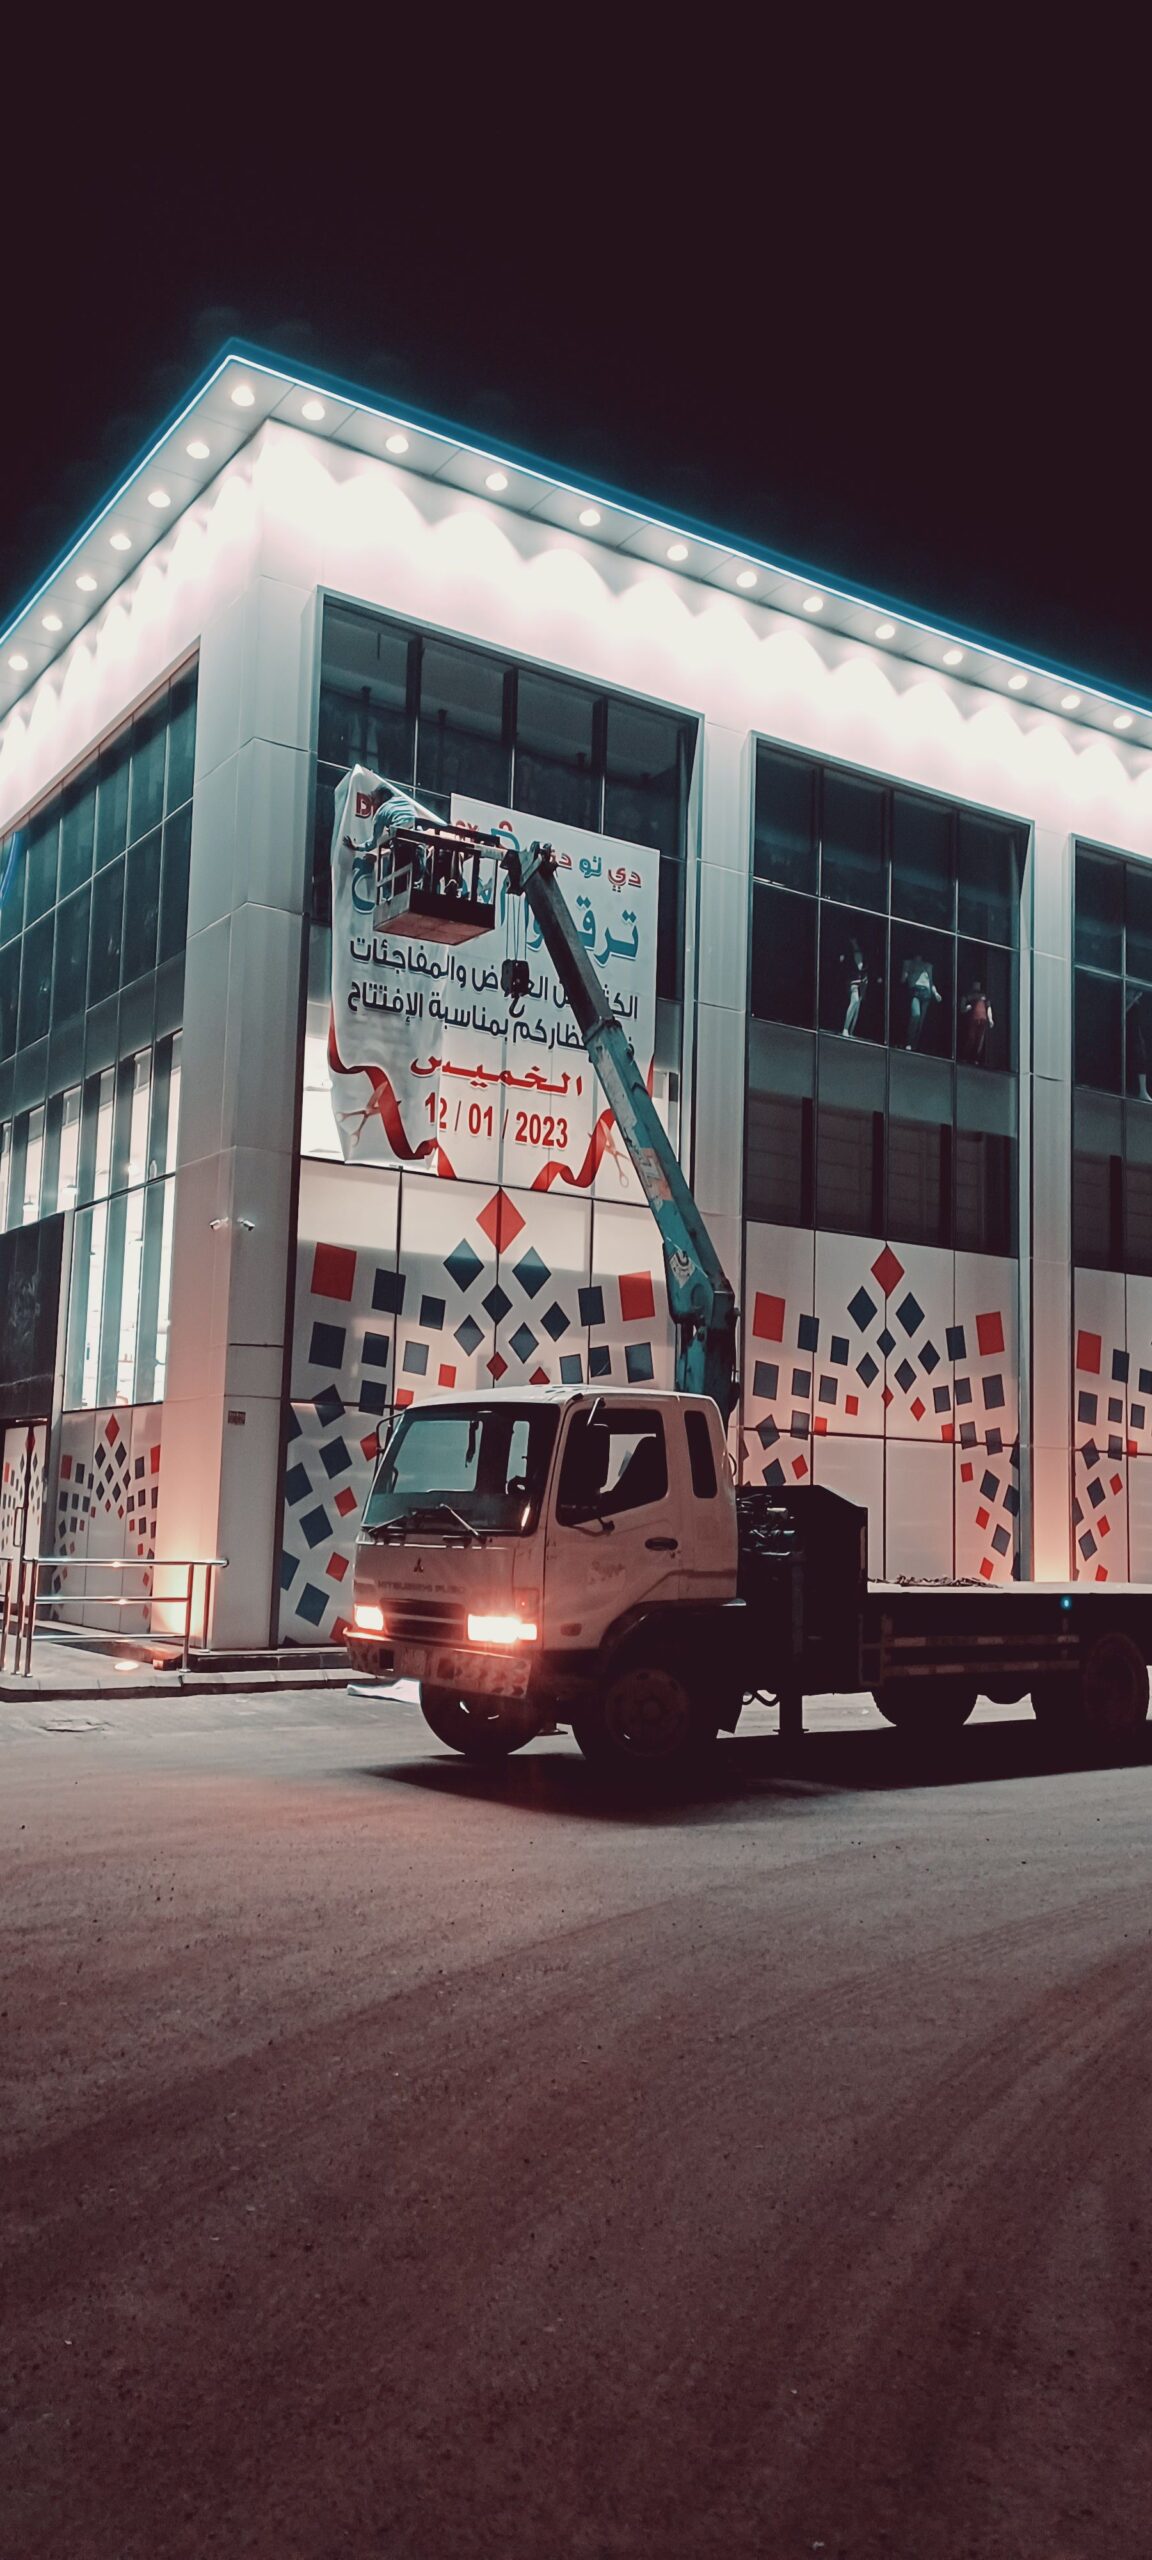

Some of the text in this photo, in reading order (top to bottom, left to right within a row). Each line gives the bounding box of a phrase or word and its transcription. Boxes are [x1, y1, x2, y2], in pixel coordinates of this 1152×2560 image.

[608, 867, 641, 893] دي
[350, 937, 467, 989] والمفاجئات
[348, 981, 423, 1023] الإفتتاح
[428, 991, 508, 1042] بمناسبة
[410, 1055, 583, 1096] الخميس
[425, 1091, 448, 1130] 12
[468, 1102, 493, 1137] 01
[515, 1110, 568, 1149] 2023
